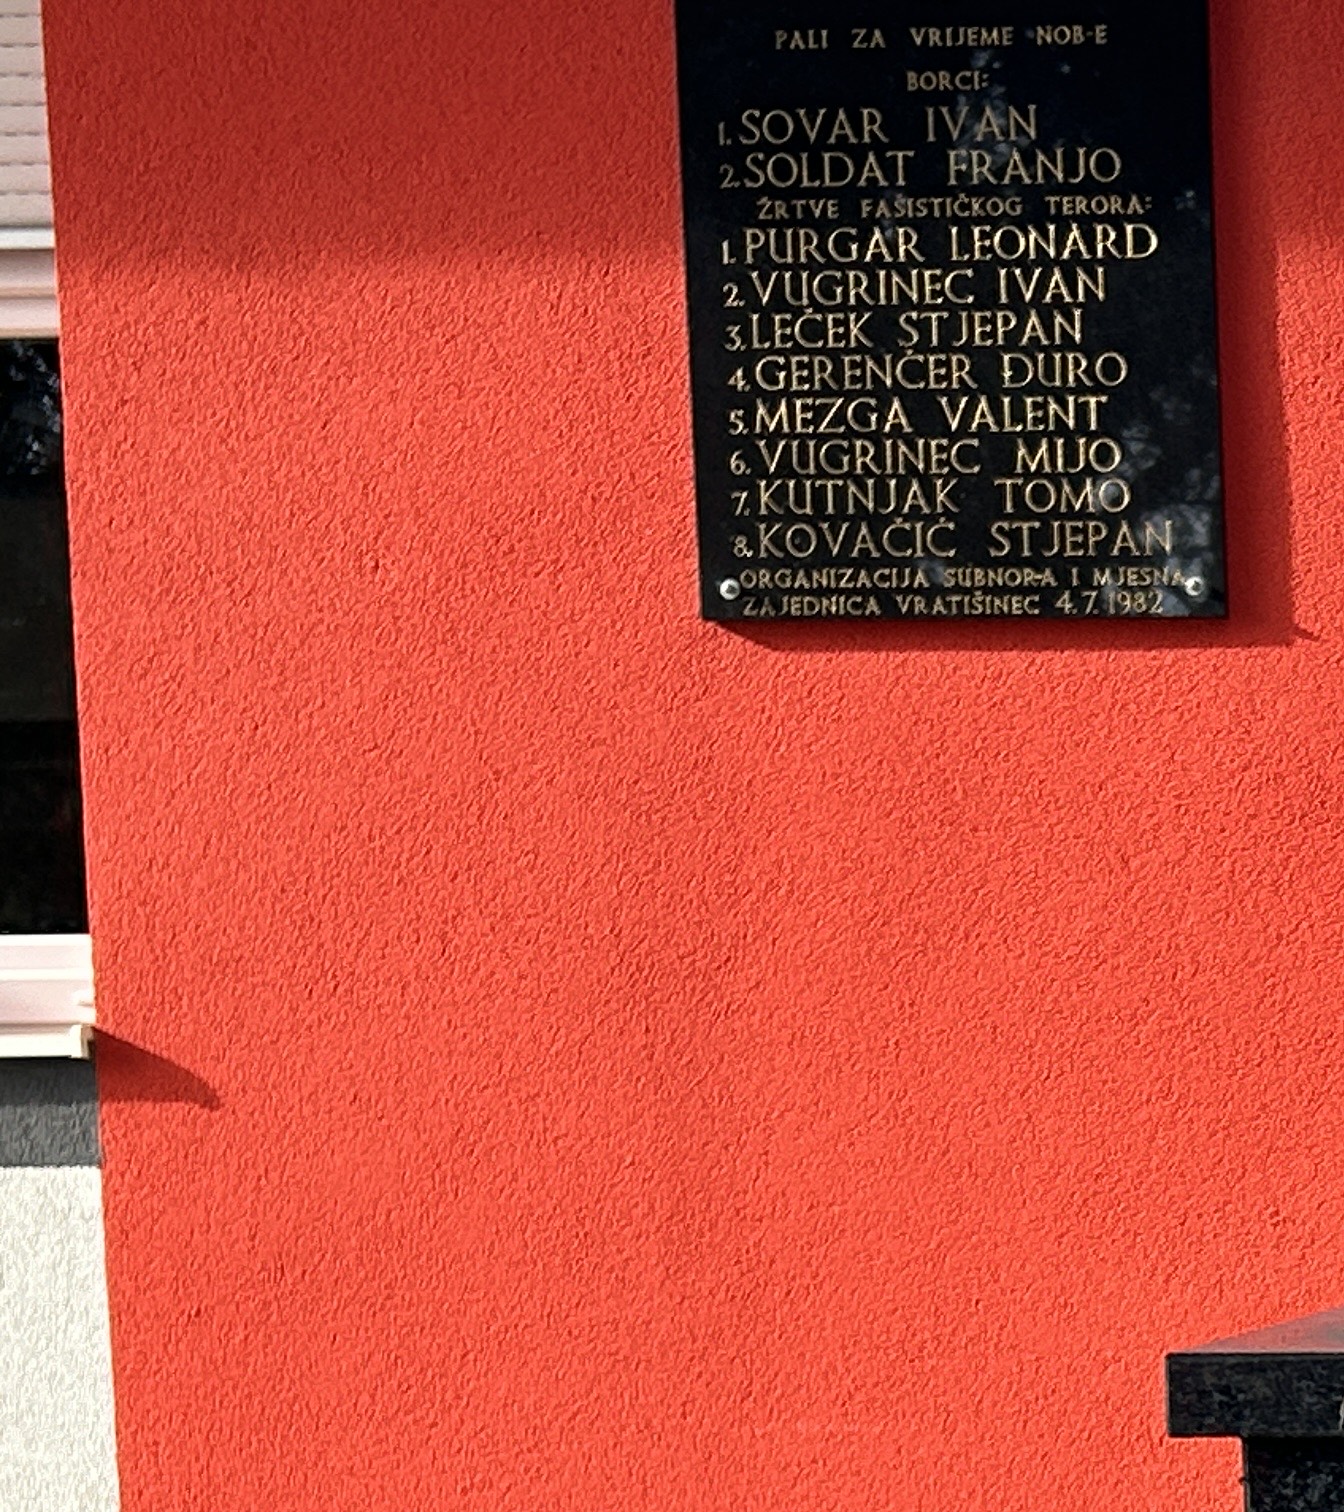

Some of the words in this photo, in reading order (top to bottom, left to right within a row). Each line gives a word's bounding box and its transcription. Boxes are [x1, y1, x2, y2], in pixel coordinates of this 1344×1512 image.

[774, 29, 829, 50] PALI
[851, 28, 887, 49] ZA
[909, 26, 1014, 47] VRIJEME
[1035, 25, 1108, 46] NOB-E
[925, 105, 1038, 143] IVAN
[743, 150, 915, 189] SOLDAT
[946, 148, 1122, 186] FRANJO
[757, 196, 840, 220] ŽRTVE
[860, 194, 1023, 219] FAŠISTIČKOG
[743, 226, 926, 265] PURGAR
[949, 222, 1160, 262] LEONARD
[749, 267, 976, 308] VUGRINEC
[997, 265, 1107, 304] IVAN
[897, 308, 1084, 348] STJEPAN
[753, 397, 914, 435] MEZGA
[936, 394, 1109, 434] VALENT
[755, 438, 983, 476] VUGRINEC
[1014, 436, 1124, 474] MIJO
[757, 477, 962, 516] KUTNJAK
[994, 475, 1132, 515] TOMO
[986, 518, 1175, 558] STJEPAN
[739, 567, 930, 590] ORGANIZACIJA
[943, 563, 1058, 589] SUBNOR-A
[1071, 567, 1080, 587] I
[1092, 565, 1188, 588] MJESNA
[742, 594, 882, 617] ZAJEDNICA
[894, 590, 1041, 617] VRATIŠINEC
